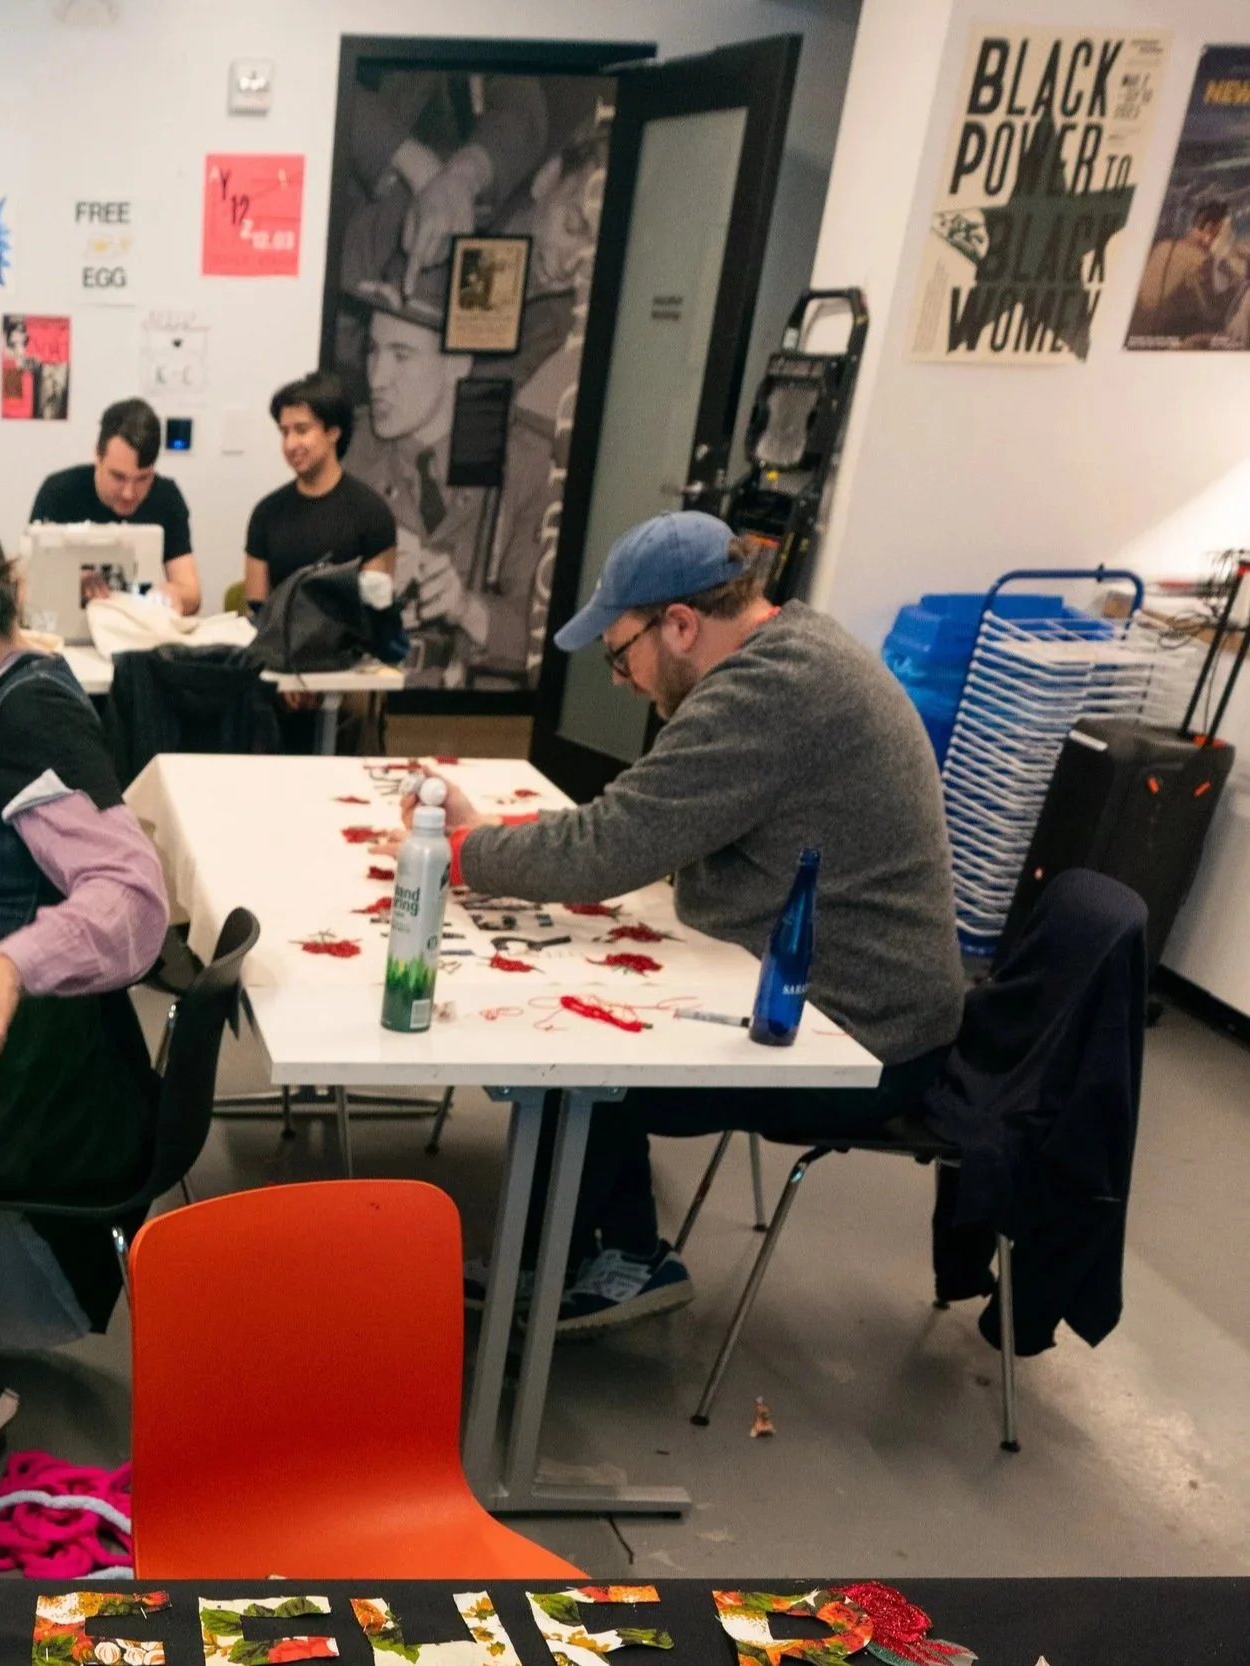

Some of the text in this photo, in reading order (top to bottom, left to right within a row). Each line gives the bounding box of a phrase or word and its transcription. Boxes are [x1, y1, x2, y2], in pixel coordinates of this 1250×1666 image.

[967, 37, 1124, 118] BLACK
[949, 121, 1133, 197] POWER TO
[75, 201, 131, 224] FREE
[82, 266, 127, 288] EGG
